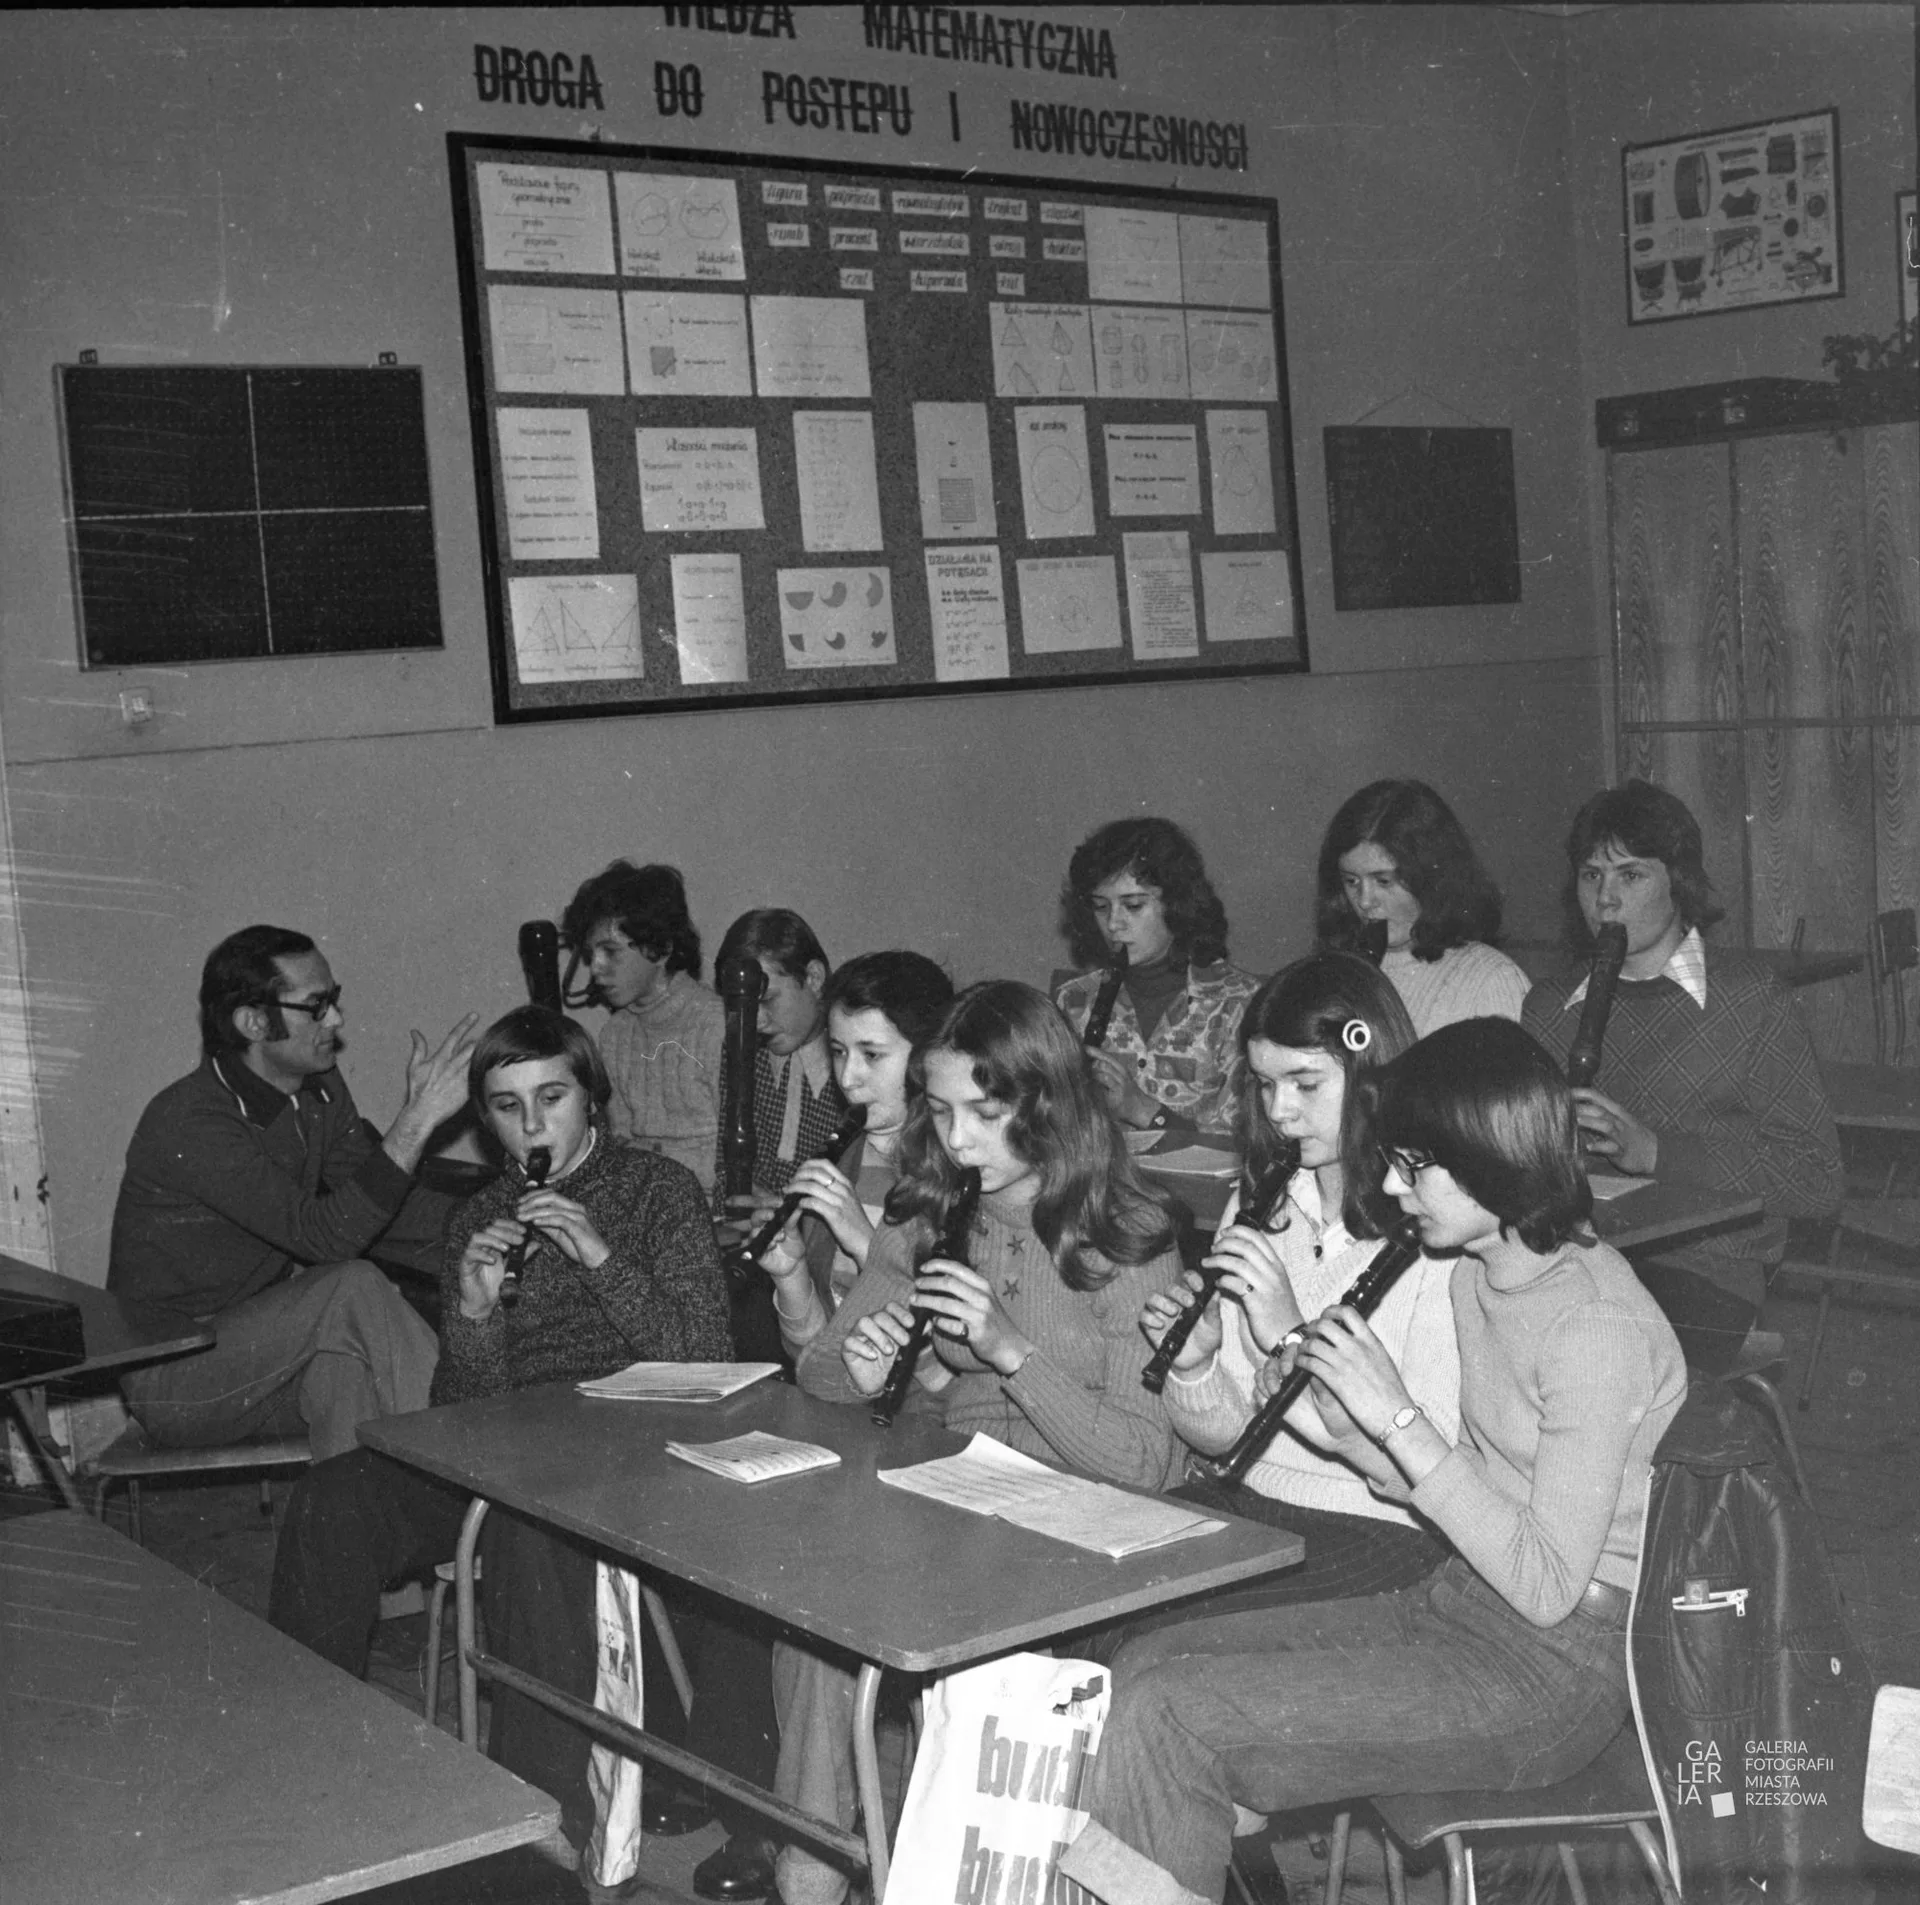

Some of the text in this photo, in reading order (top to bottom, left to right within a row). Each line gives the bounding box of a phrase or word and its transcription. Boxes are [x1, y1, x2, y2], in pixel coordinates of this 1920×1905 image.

[863, 5, 1118, 80] MATEMATYCZNA
[473, 43, 1249, 172] DROGA DO POSTEPU I NOWOCZESNOSCI
